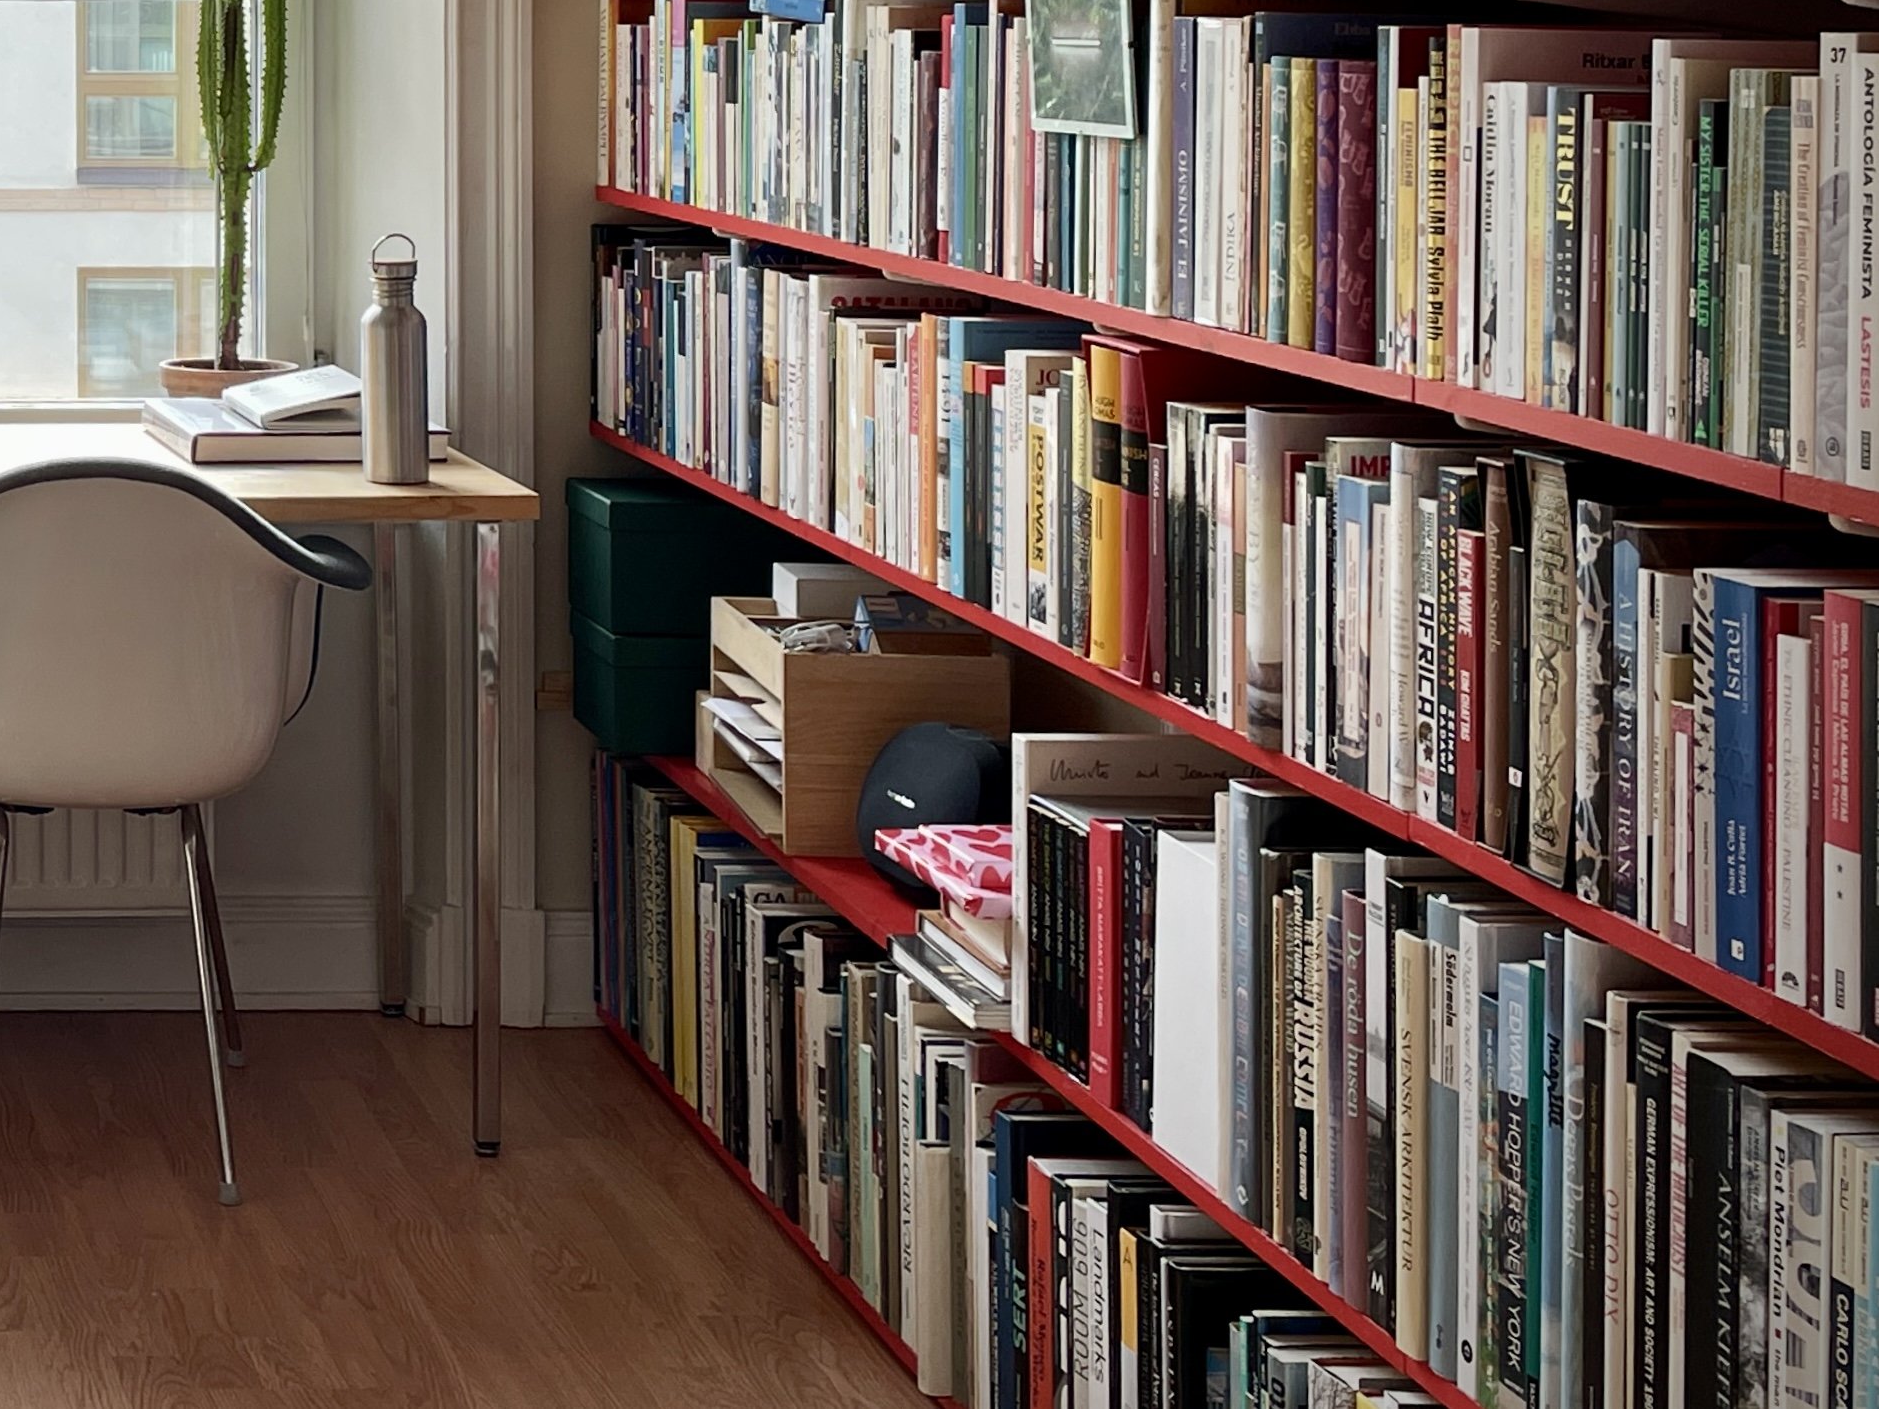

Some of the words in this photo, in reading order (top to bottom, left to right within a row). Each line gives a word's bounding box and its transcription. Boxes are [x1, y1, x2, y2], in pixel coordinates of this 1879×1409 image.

[1830, 47, 1846, 63] 37
[1448, 38, 1460, 158] RESPECT
[1485, 94, 1497, 161] Caitlin
[1861, 68, 1875, 187] ANTOLOGÍA
[1428, 137, 1446, 163] THE
[1699, 116, 1712, 142] MY
[1796, 143, 1811, 162] The
[1428, 169, 1446, 200] BELL
[1555, 107, 1576, 231] TRUST
[1796, 164, 1811, 209] Creation
[1178, 149, 1189, 250] JAINISMO
[1428, 204, 1446, 236] JAR
[1485, 169, 1497, 233] Moran
[1699, 198, 1712, 223] THE
[1796, 211, 1811, 222] of
[1178, 253, 1189, 280] EL
[1225, 212, 1236, 281] INDIKA
[1428, 247, 1446, 295] Sylvia
[1698, 228, 1710, 275] SERIAL
[1796, 225, 1811, 271] Feminist
[1861, 192, 1875, 299] FEMINISTA
[1428, 301, 1446, 342] Plath
[1697, 279, 1709, 328] KILLER
[1796, 274, 1811, 349] Consciousness
[910, 348, 918, 430] SAPIENS
[1860, 316, 1872, 408] LASTESIS
[1035, 435, 1045, 562] POSTWAR
[1448, 491, 1456, 518] AN
[1440, 539, 1447, 563] OF
[1448, 525, 1456, 606] AFRICAN
[1458, 536, 1473, 587] BLACK
[1489, 521, 1502, 592] Arabian
[1458, 590, 1473, 637] WAVE
[1489, 598, 1502, 654] Sands
[1617, 593, 1632, 610] A
[1418, 599, 1434, 720] AFRICA
[1448, 612, 1456, 689] HISTORY
[1722, 619, 1740, 700] Israel
[1782, 648, 1792, 669] The
[1840, 622, 1849, 655] SIRIA.
[1840, 657, 1849, 671] EL
[1460, 670, 1471, 692] KIM
[1617, 621, 1632, 751] HISTORY
[1782, 673, 1792, 737] ETHNIC
[1840, 673, 1849, 700] PAÍS
[1840, 701, 1849, 717] DE
[1439, 704, 1447, 772] BADAWI
[1448, 710, 1456, 775] ZEINAB
[1460, 693, 1471, 742] GHATTAS
[1840, 719, 1849, 741] LAS
[1136, 763, 1160, 779] and
[1617, 758, 1632, 799] OF
[1782, 739, 1792, 830] CLEANSING
[1840, 742, 1849, 783] ALMAS
[1840, 786, 1849, 823] ROTAS
[1617, 806, 1632, 878] IRAN
[1782, 850, 1792, 933] PALESTINE
[1293, 885, 1303, 981] ARCHITECTURE
[1304, 919, 1315, 942] THE
[1347, 930, 1364, 971] De
[1293, 983, 1303, 999] OF
[1304, 944, 1315, 1004] WOODEN
[1446, 952, 1457, 1028] Södermalm
[1347, 977, 1364, 1033] röda
[1293, 1000, 1315, 1110] RUSSIA
[1347, 1043, 1364, 1118] husen
[1401, 1028, 1413, 1120] SVENSK
[1507, 1000, 1523, 1106] EDWARD
[1672, 1063, 1686, 1098] ART
[900, 1076, 912, 1158] BOFILL
[1566, 1095, 1584, 1176] Degas
[1646, 1098, 1656, 1157] GERMAN
[1672, 1103, 1686, 1128] OF
[1507, 1111, 1523, 1232] HOPPER'S
[1530, 1123, 1540, 1179] Edward
[1672, 1134, 1686, 1168] THE
[1774, 1145, 1785, 1195] Piet
[900, 1163, 912, 1274] RICARDO
[1401, 1123, 1413, 1272] ARKITEKTUR
[1529, 1186, 1539, 1245] Hopper
[1566, 1182, 1584, 1268] Pastels
[1606, 1189, 1619, 1264] OTTO
[1672, 1169, 1686, 1279] HOLOCAUST
[1074, 1217, 1089, 1277] 606
[1507, 1237, 1523, 1298] NEW
[1718, 1171, 1732, 1310] ANSELM
[1774, 1200, 1785, 1317] Mondrian
[1012, 1258, 1026, 1354] SERT
[1037, 1258, 1046, 1319] Rafael
[1093, 1229, 1106, 1384] Landmarks
[1606, 1275, 1619, 1325] DIX
[1645, 1267, 1654, 1296] ART
[1074, 1289, 1089, 1382] ROOM
[1507, 1303, 1523, 1371] YORK
[1645, 1298, 1654, 1325] AND
[1836, 1294, 1849, 1365] CARLO
[1037, 1323, 1046, 1382] Moneo
[1644, 1326, 1654, 1381] SOCIETY
